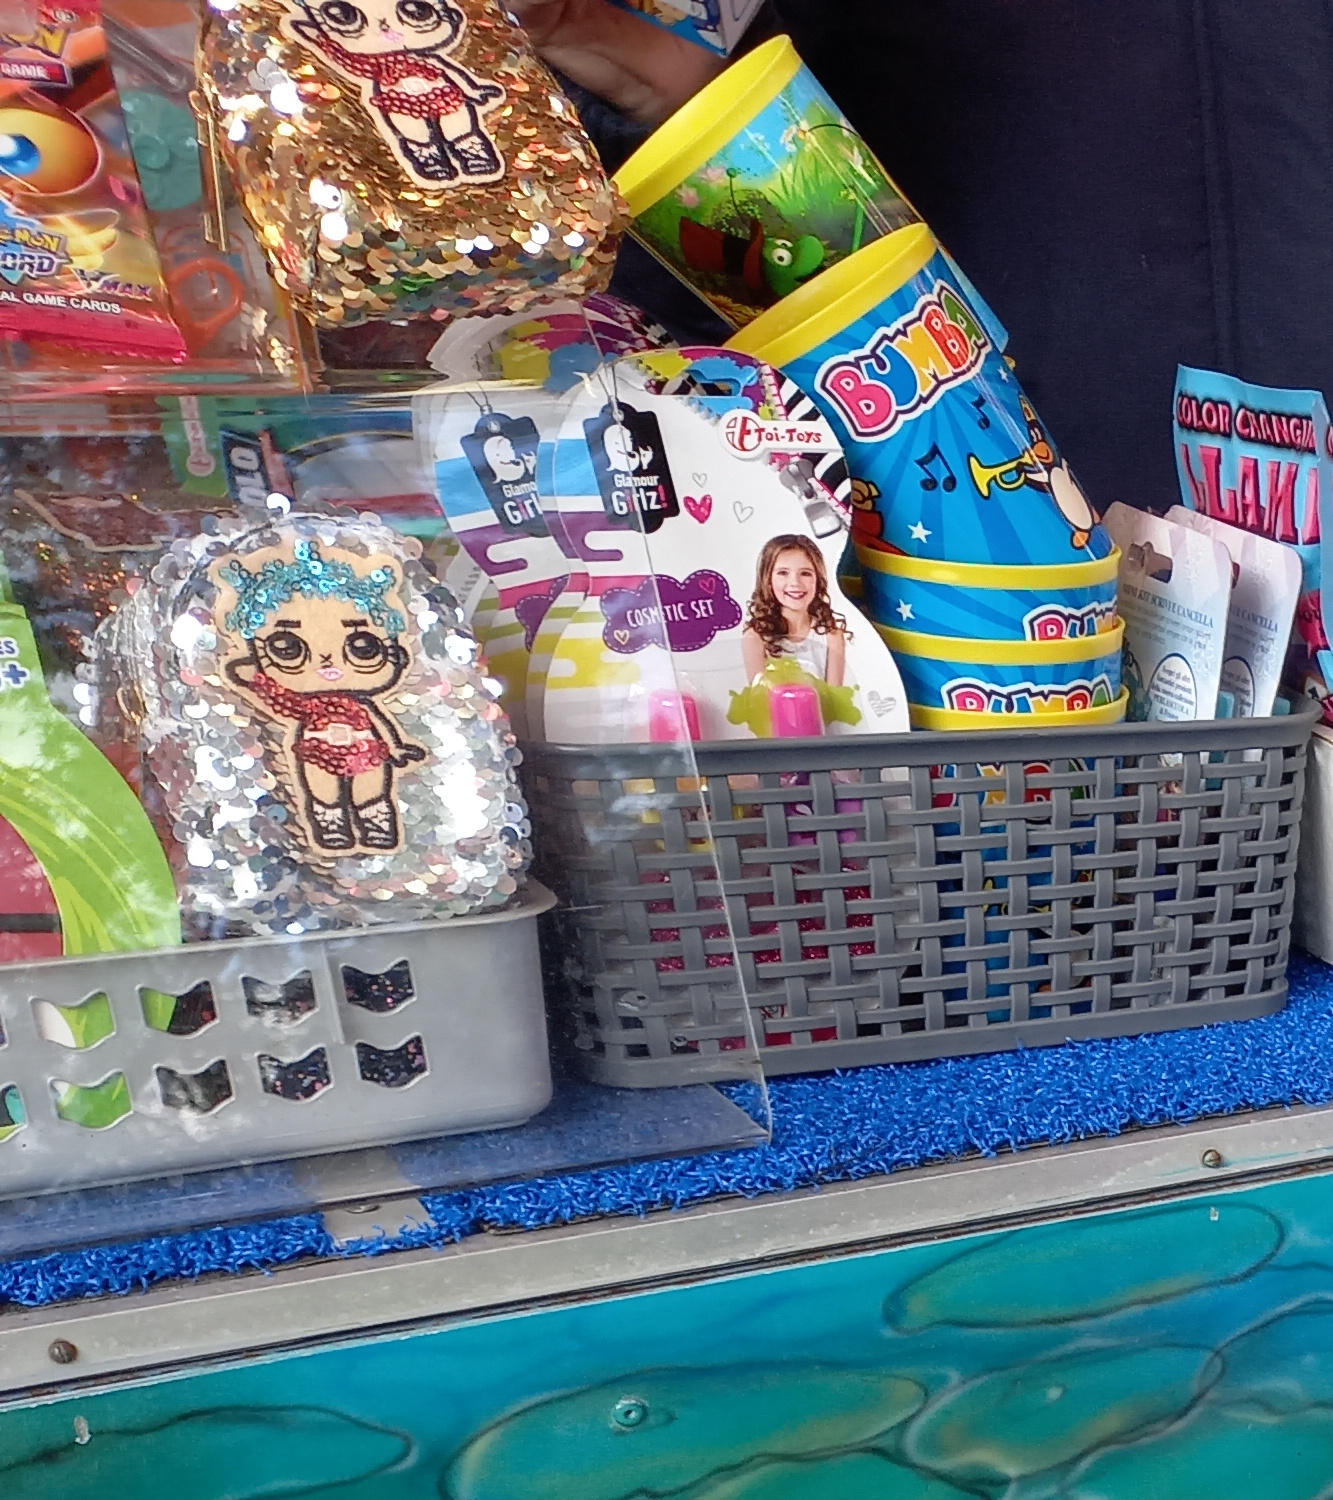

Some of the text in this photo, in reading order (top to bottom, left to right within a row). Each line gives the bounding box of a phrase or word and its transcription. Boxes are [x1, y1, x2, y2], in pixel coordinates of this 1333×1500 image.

[1, 62, 48, 79] GAME
[22, 293, 67, 307] GAME
[69, 298, 121, 314] CARDS
[822, 286, 990, 436] BUMBA
[754, 427, 822, 443] Toi-Toys
[503, 482, 536, 498] Glamo
[614, 473, 659, 488] Glamour
[503, 493, 543, 525] Girl
[611, 485, 668, 516] Girlz!
[626, 599, 715, 629] COSMETIC SET
[1177, 604, 1214, 629] CANCELLA
